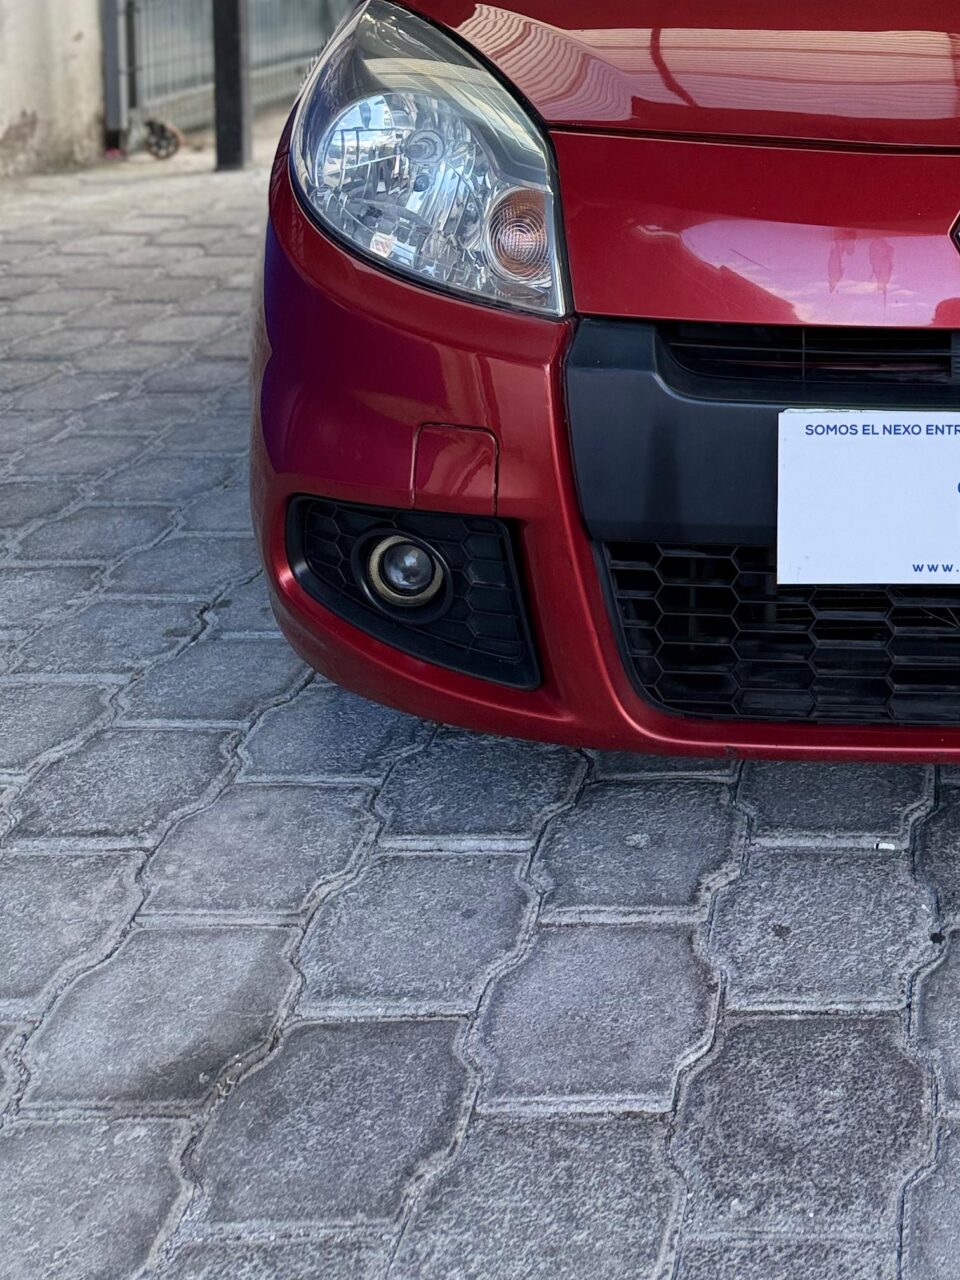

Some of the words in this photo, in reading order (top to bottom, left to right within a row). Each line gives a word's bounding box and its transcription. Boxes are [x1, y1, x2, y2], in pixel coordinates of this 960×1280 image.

[805, 424, 858, 436] SOMOS
[862, 424, 879, 436] EL
[882, 424, 922, 436] NEXO
